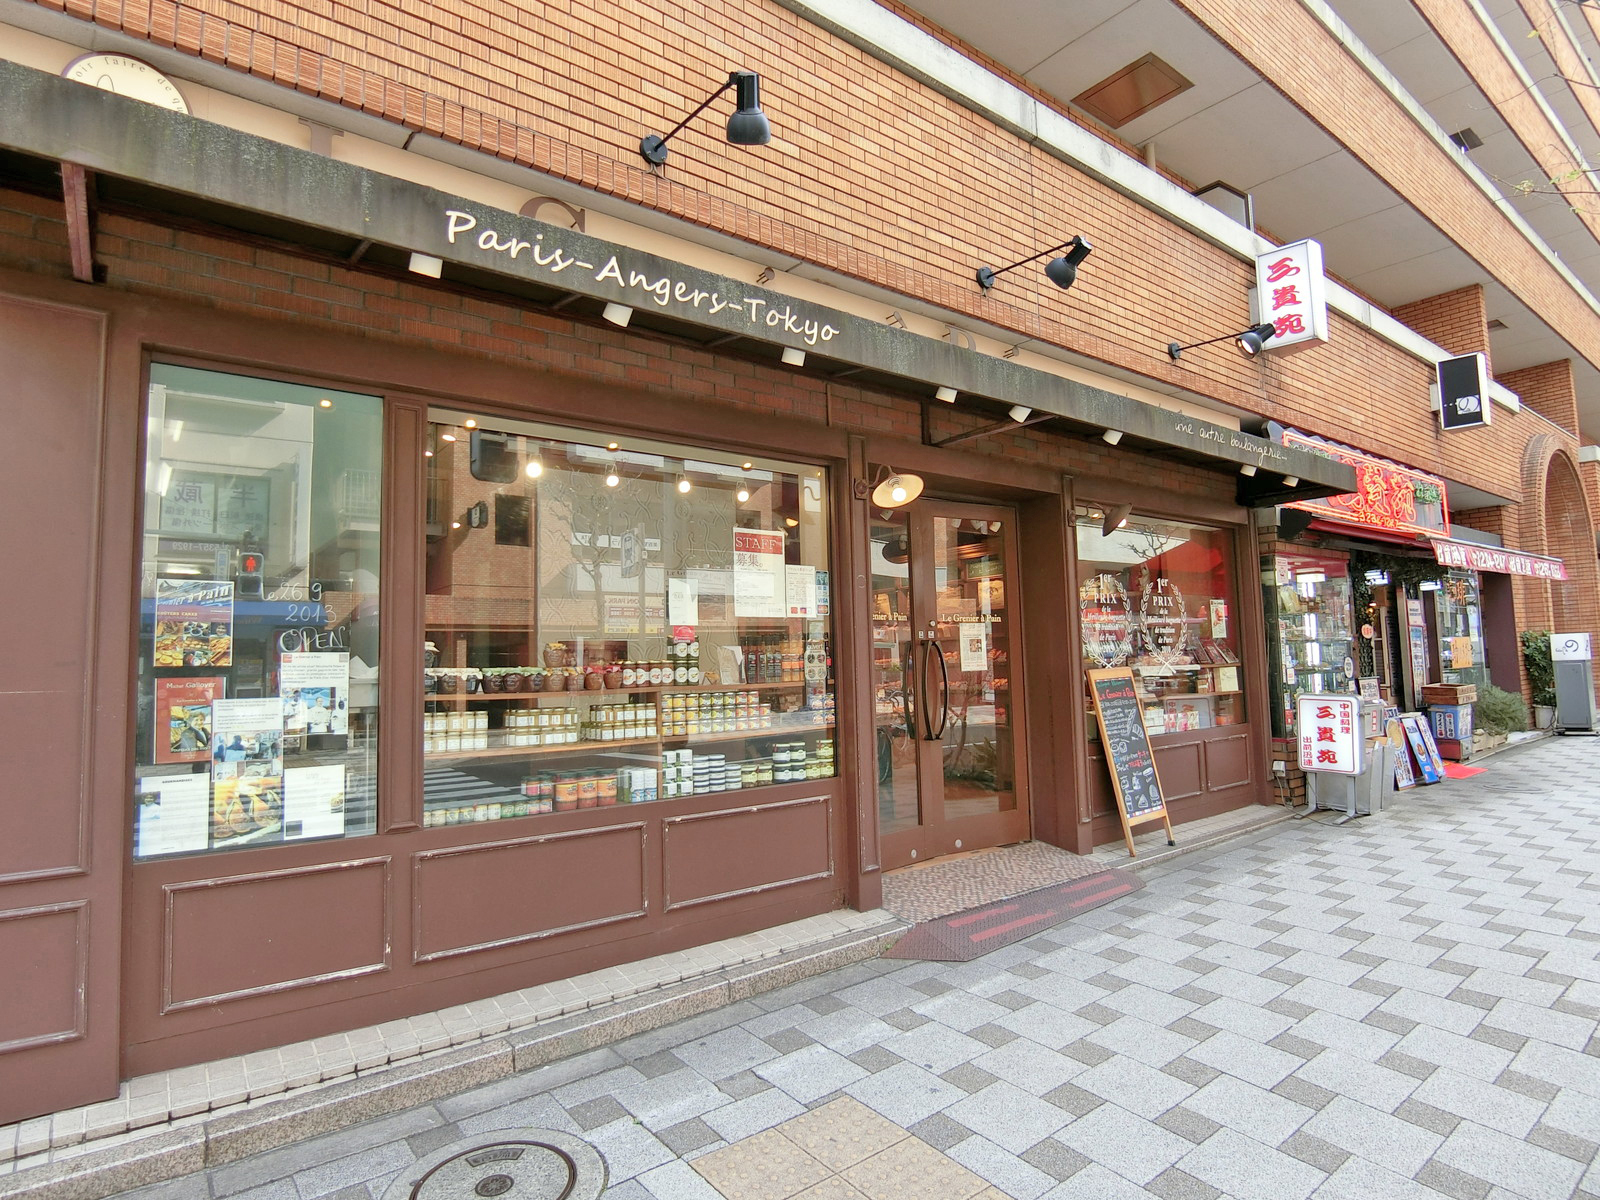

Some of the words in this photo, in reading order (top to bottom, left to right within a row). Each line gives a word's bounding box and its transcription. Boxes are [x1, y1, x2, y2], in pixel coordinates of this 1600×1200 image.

[104, 57, 146, 73] faire
[157, 77, 172, 92] de
[445, 209, 840, 346] Paris-Angers-Tokyo
[1174, 422, 1194, 435] une
[1199, 427, 1226, 444] autre
[735, 536, 777, 550] STAFF
[1099, 573, 1113, 590] 1er
[1157, 577, 1169, 594] 1er
[280, 582, 302, 601] 26
[311, 582, 322, 601] 9
[1094, 592, 1118, 604] PRIX
[1152, 595, 1174, 607] PRIX
[285, 603, 337, 623] 2013
[893, 612, 908, 621] Pain
[942, 613, 952, 622] Le
[953, 613, 979, 623] Grenier
[985, 613, 1001, 623] Pain
[280, 626, 346, 652] OPEN
[1316, 705, 1338, 764] 三貴苑
